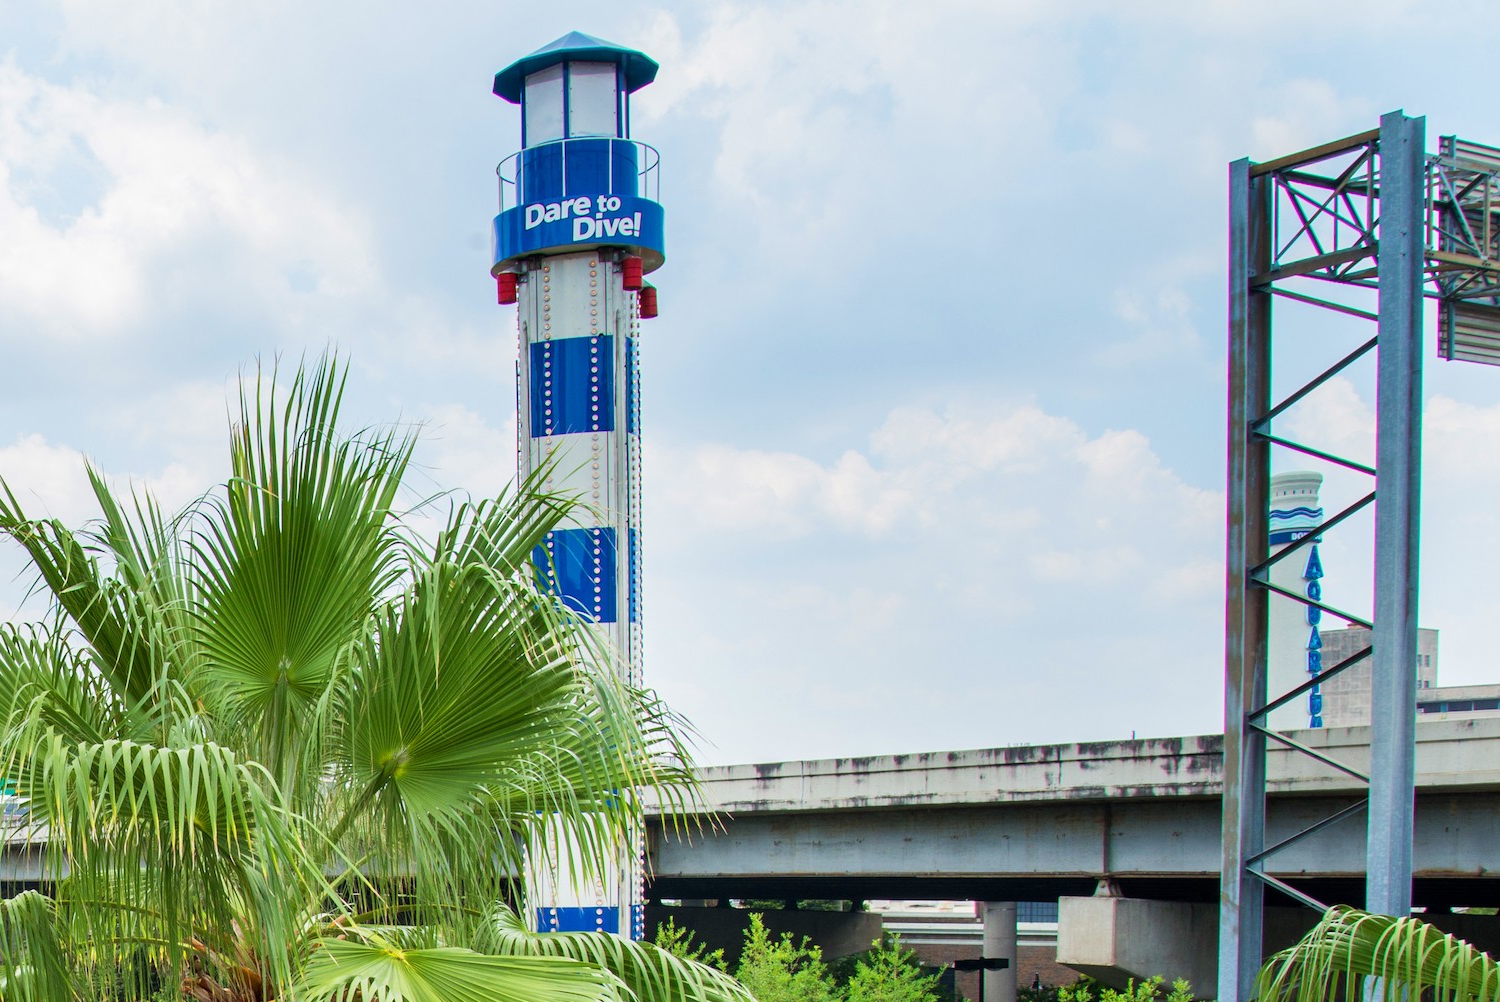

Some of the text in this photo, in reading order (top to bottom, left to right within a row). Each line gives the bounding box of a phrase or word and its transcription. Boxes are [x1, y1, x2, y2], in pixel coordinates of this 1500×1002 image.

[525, 194, 621, 230] Dare to
[573, 212, 642, 242] Dive!
